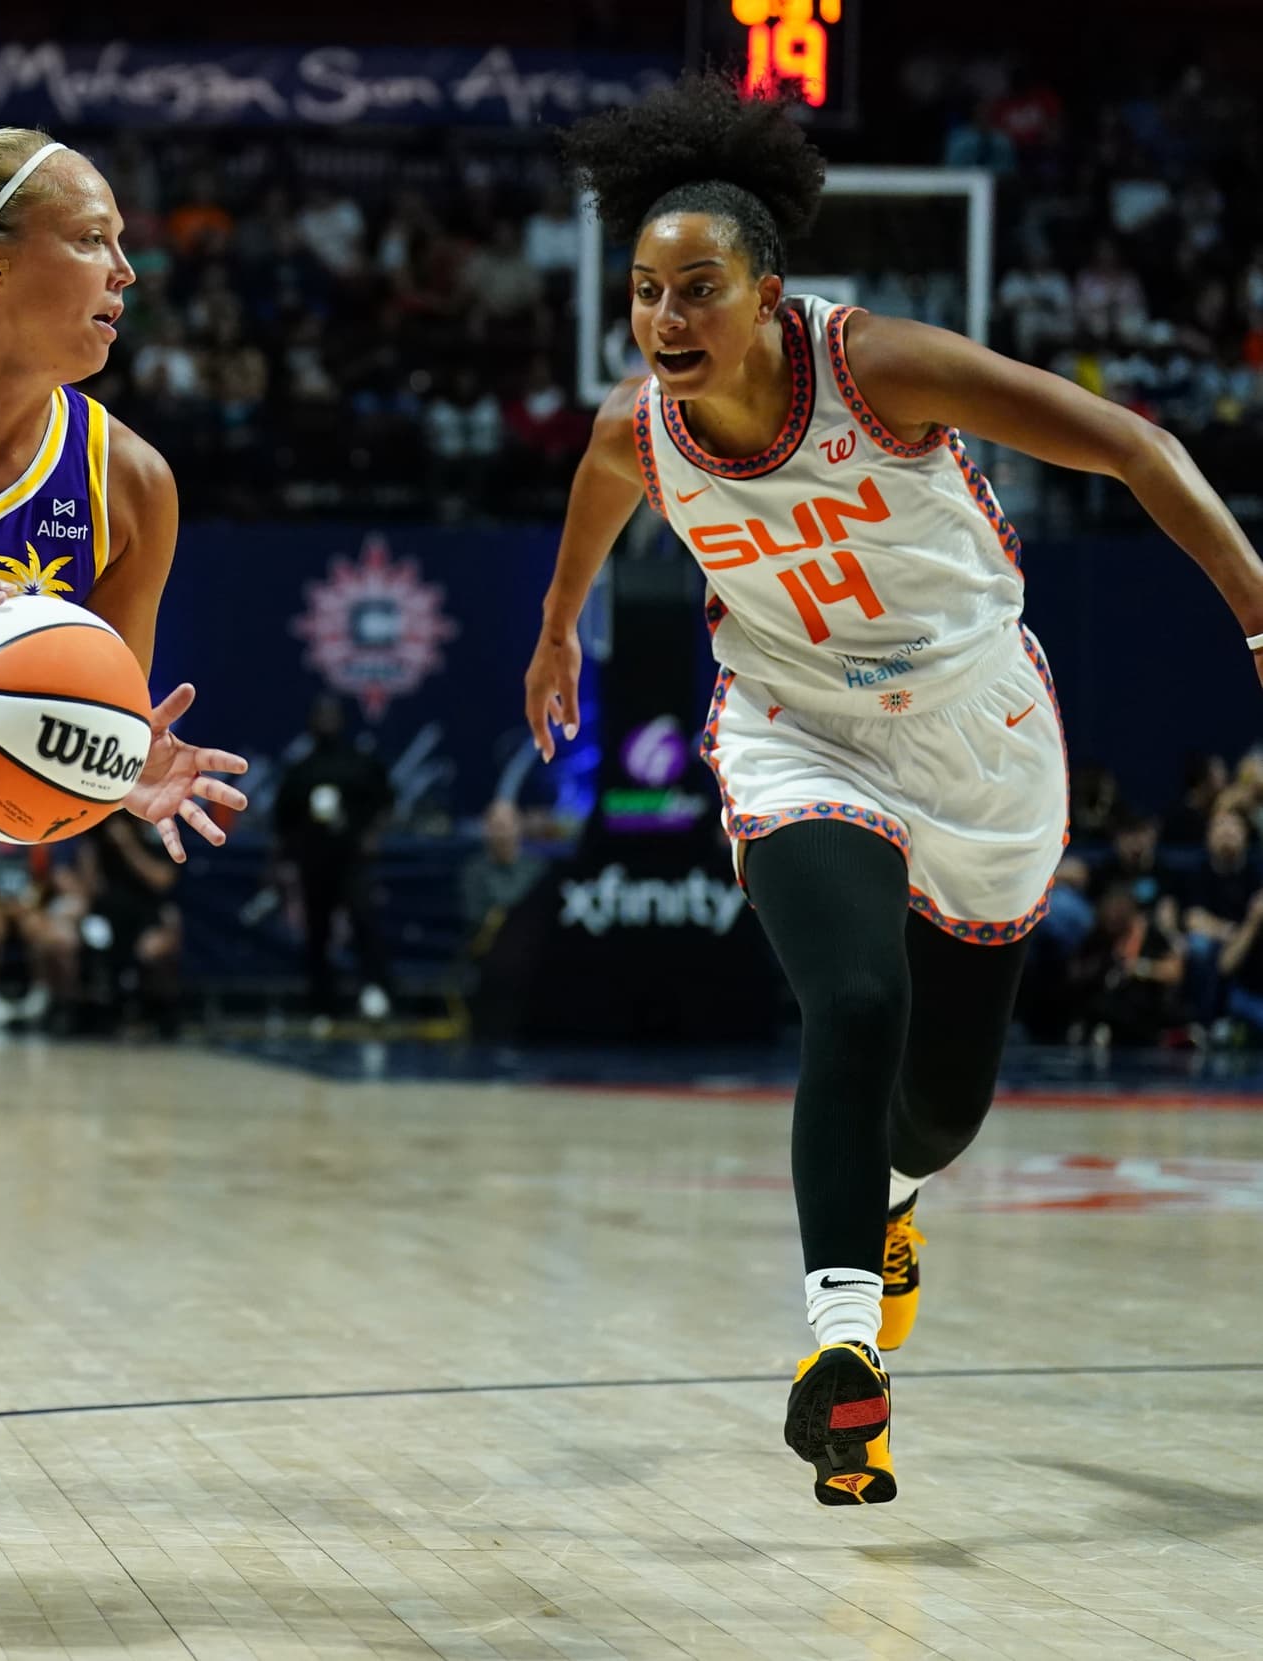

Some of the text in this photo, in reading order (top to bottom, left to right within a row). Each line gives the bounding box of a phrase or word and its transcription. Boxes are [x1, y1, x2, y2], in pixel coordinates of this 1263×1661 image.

[293, 45, 442, 123] Sun
[37, 519, 88, 540] Albert
[689, 476, 891, 570] SUN
[776, 551, 885, 645] 14
[845, 658, 914, 688] Health
[560, 864, 747, 935] xfinity
